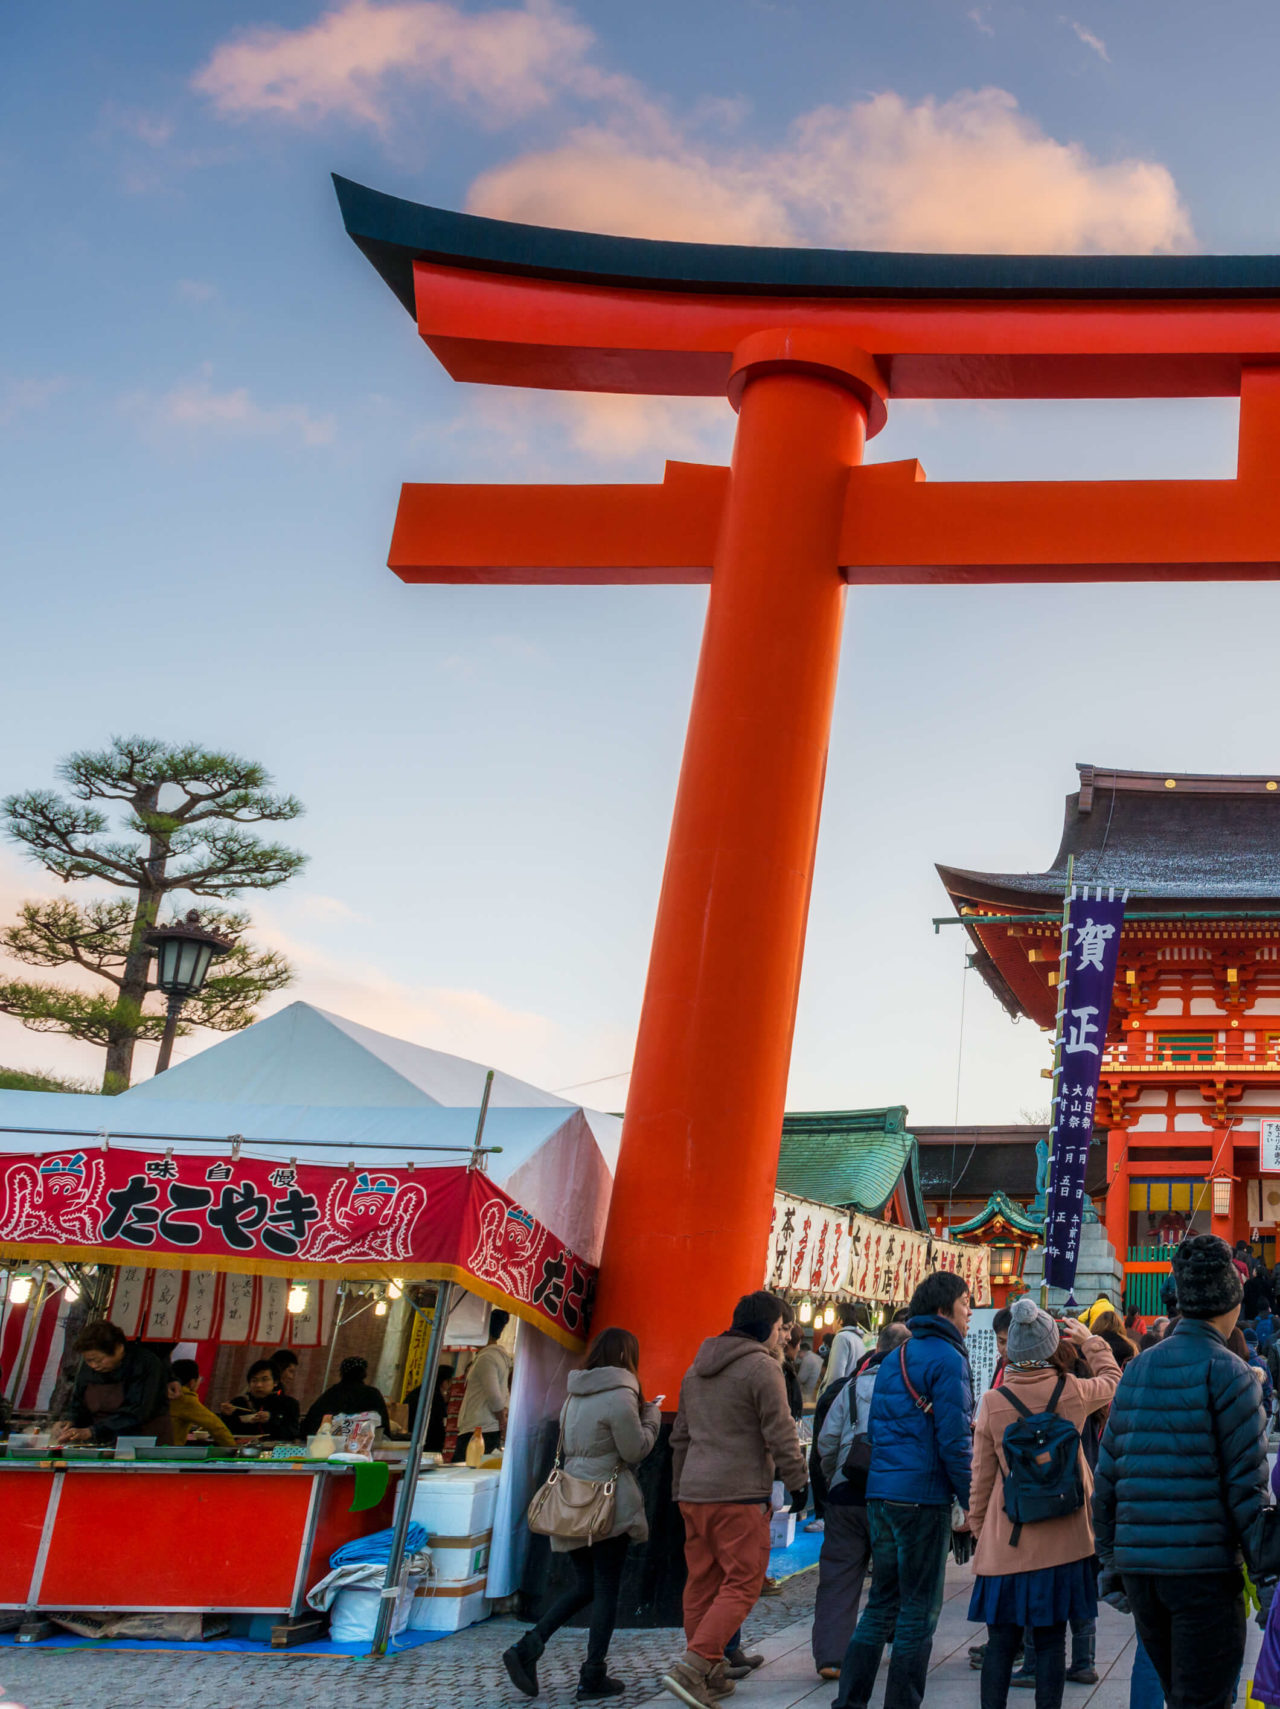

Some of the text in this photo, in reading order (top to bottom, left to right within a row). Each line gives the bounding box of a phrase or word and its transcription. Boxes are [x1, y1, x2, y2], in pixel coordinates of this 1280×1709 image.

[1065, 918, 1115, 1056] 賀正
[1068, 1084, 1083, 1129] 大山祭
[145, 1158, 297, 1188] 味自慢
[101, 1175, 321, 1256] たこやき
